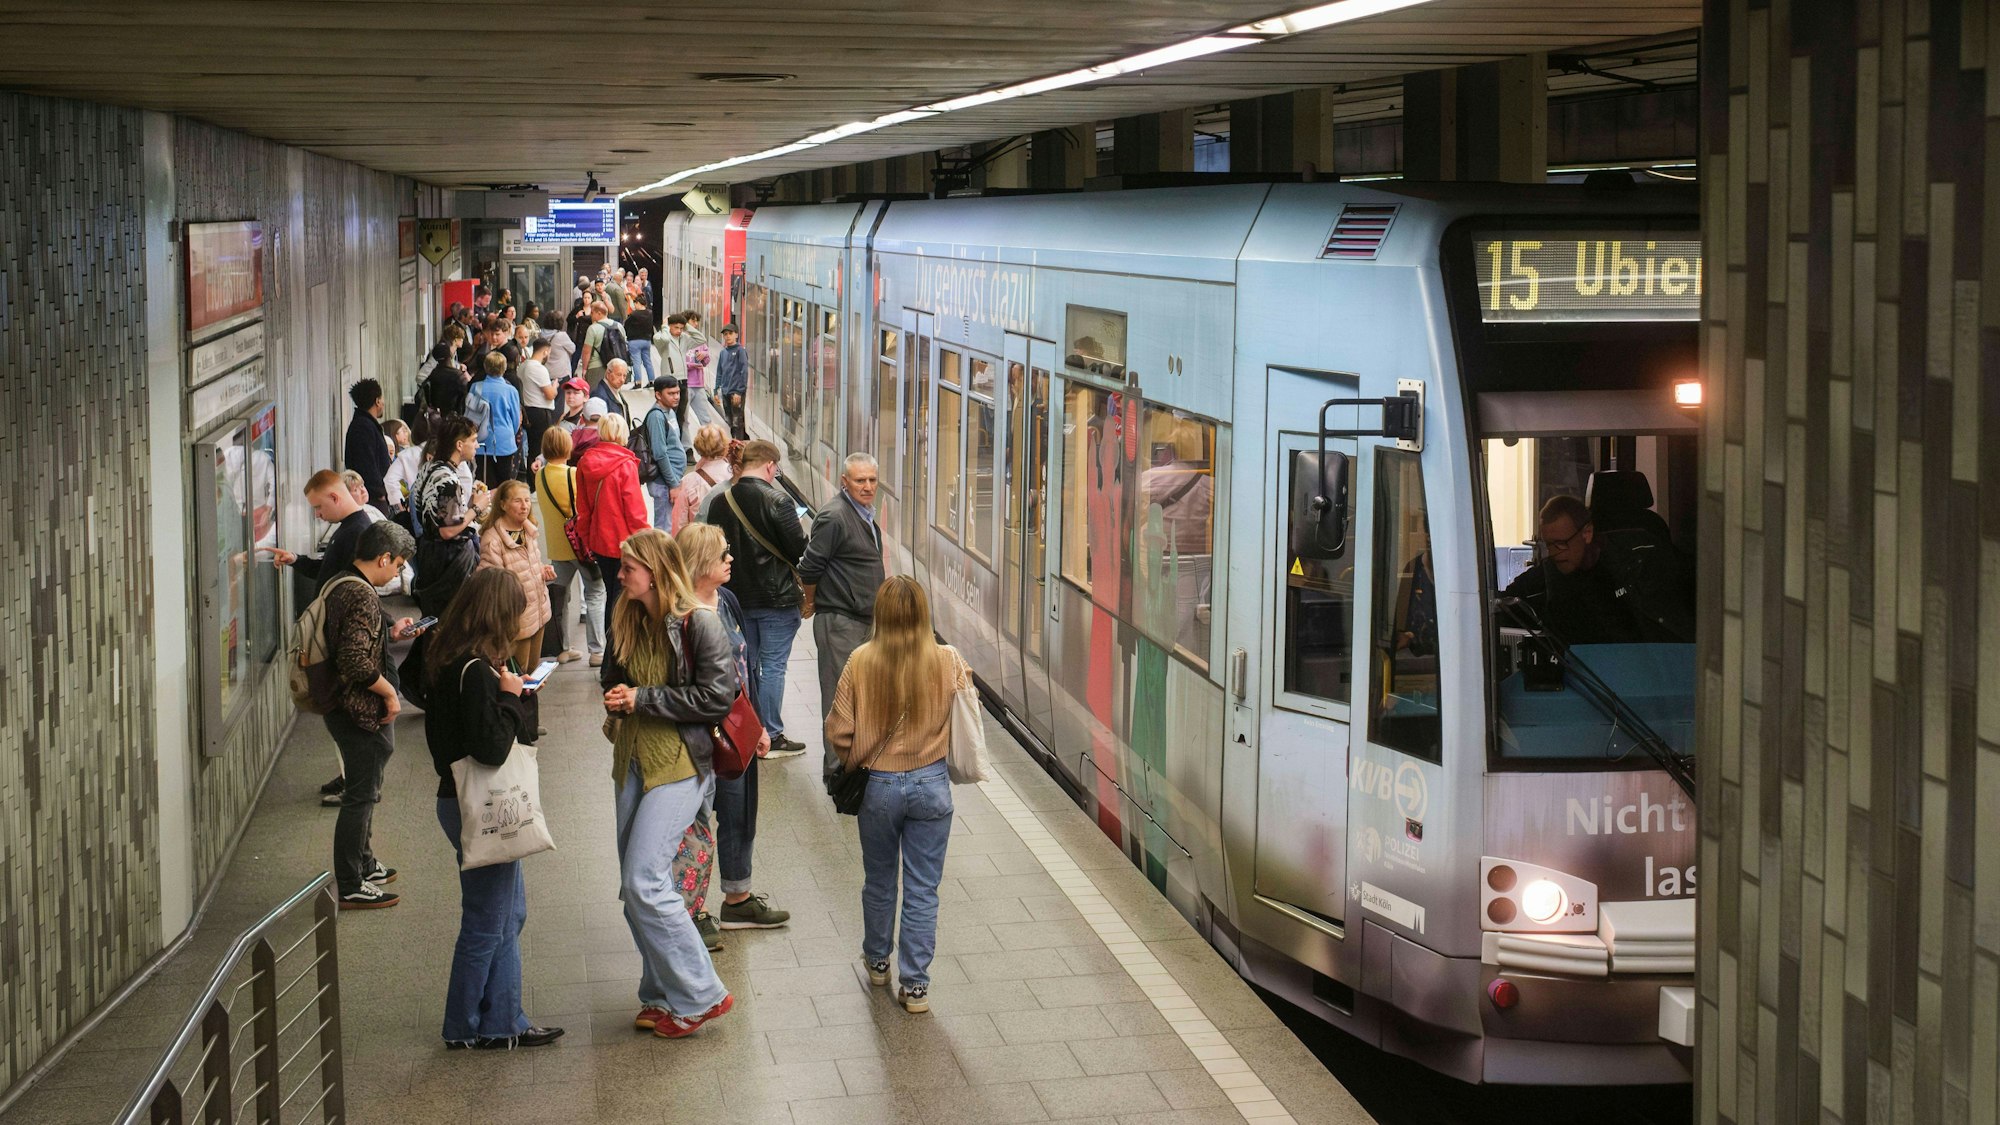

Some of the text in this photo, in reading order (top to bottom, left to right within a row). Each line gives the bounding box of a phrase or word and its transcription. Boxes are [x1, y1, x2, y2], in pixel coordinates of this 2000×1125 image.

[915, 246, 932, 311] Du
[933, 243, 987, 338] gehörst
[990, 245, 1037, 335] dazu!
[1487, 240, 1543, 310] 15
[943, 555, 980, 613] Vorbild sein
[1350, 756, 1394, 801] KVB
[1565, 792, 1687, 837] Nicht
[1384, 834, 1420, 862] POLIZEI
[1362, 889, 1393, 912] Stadt Köln
